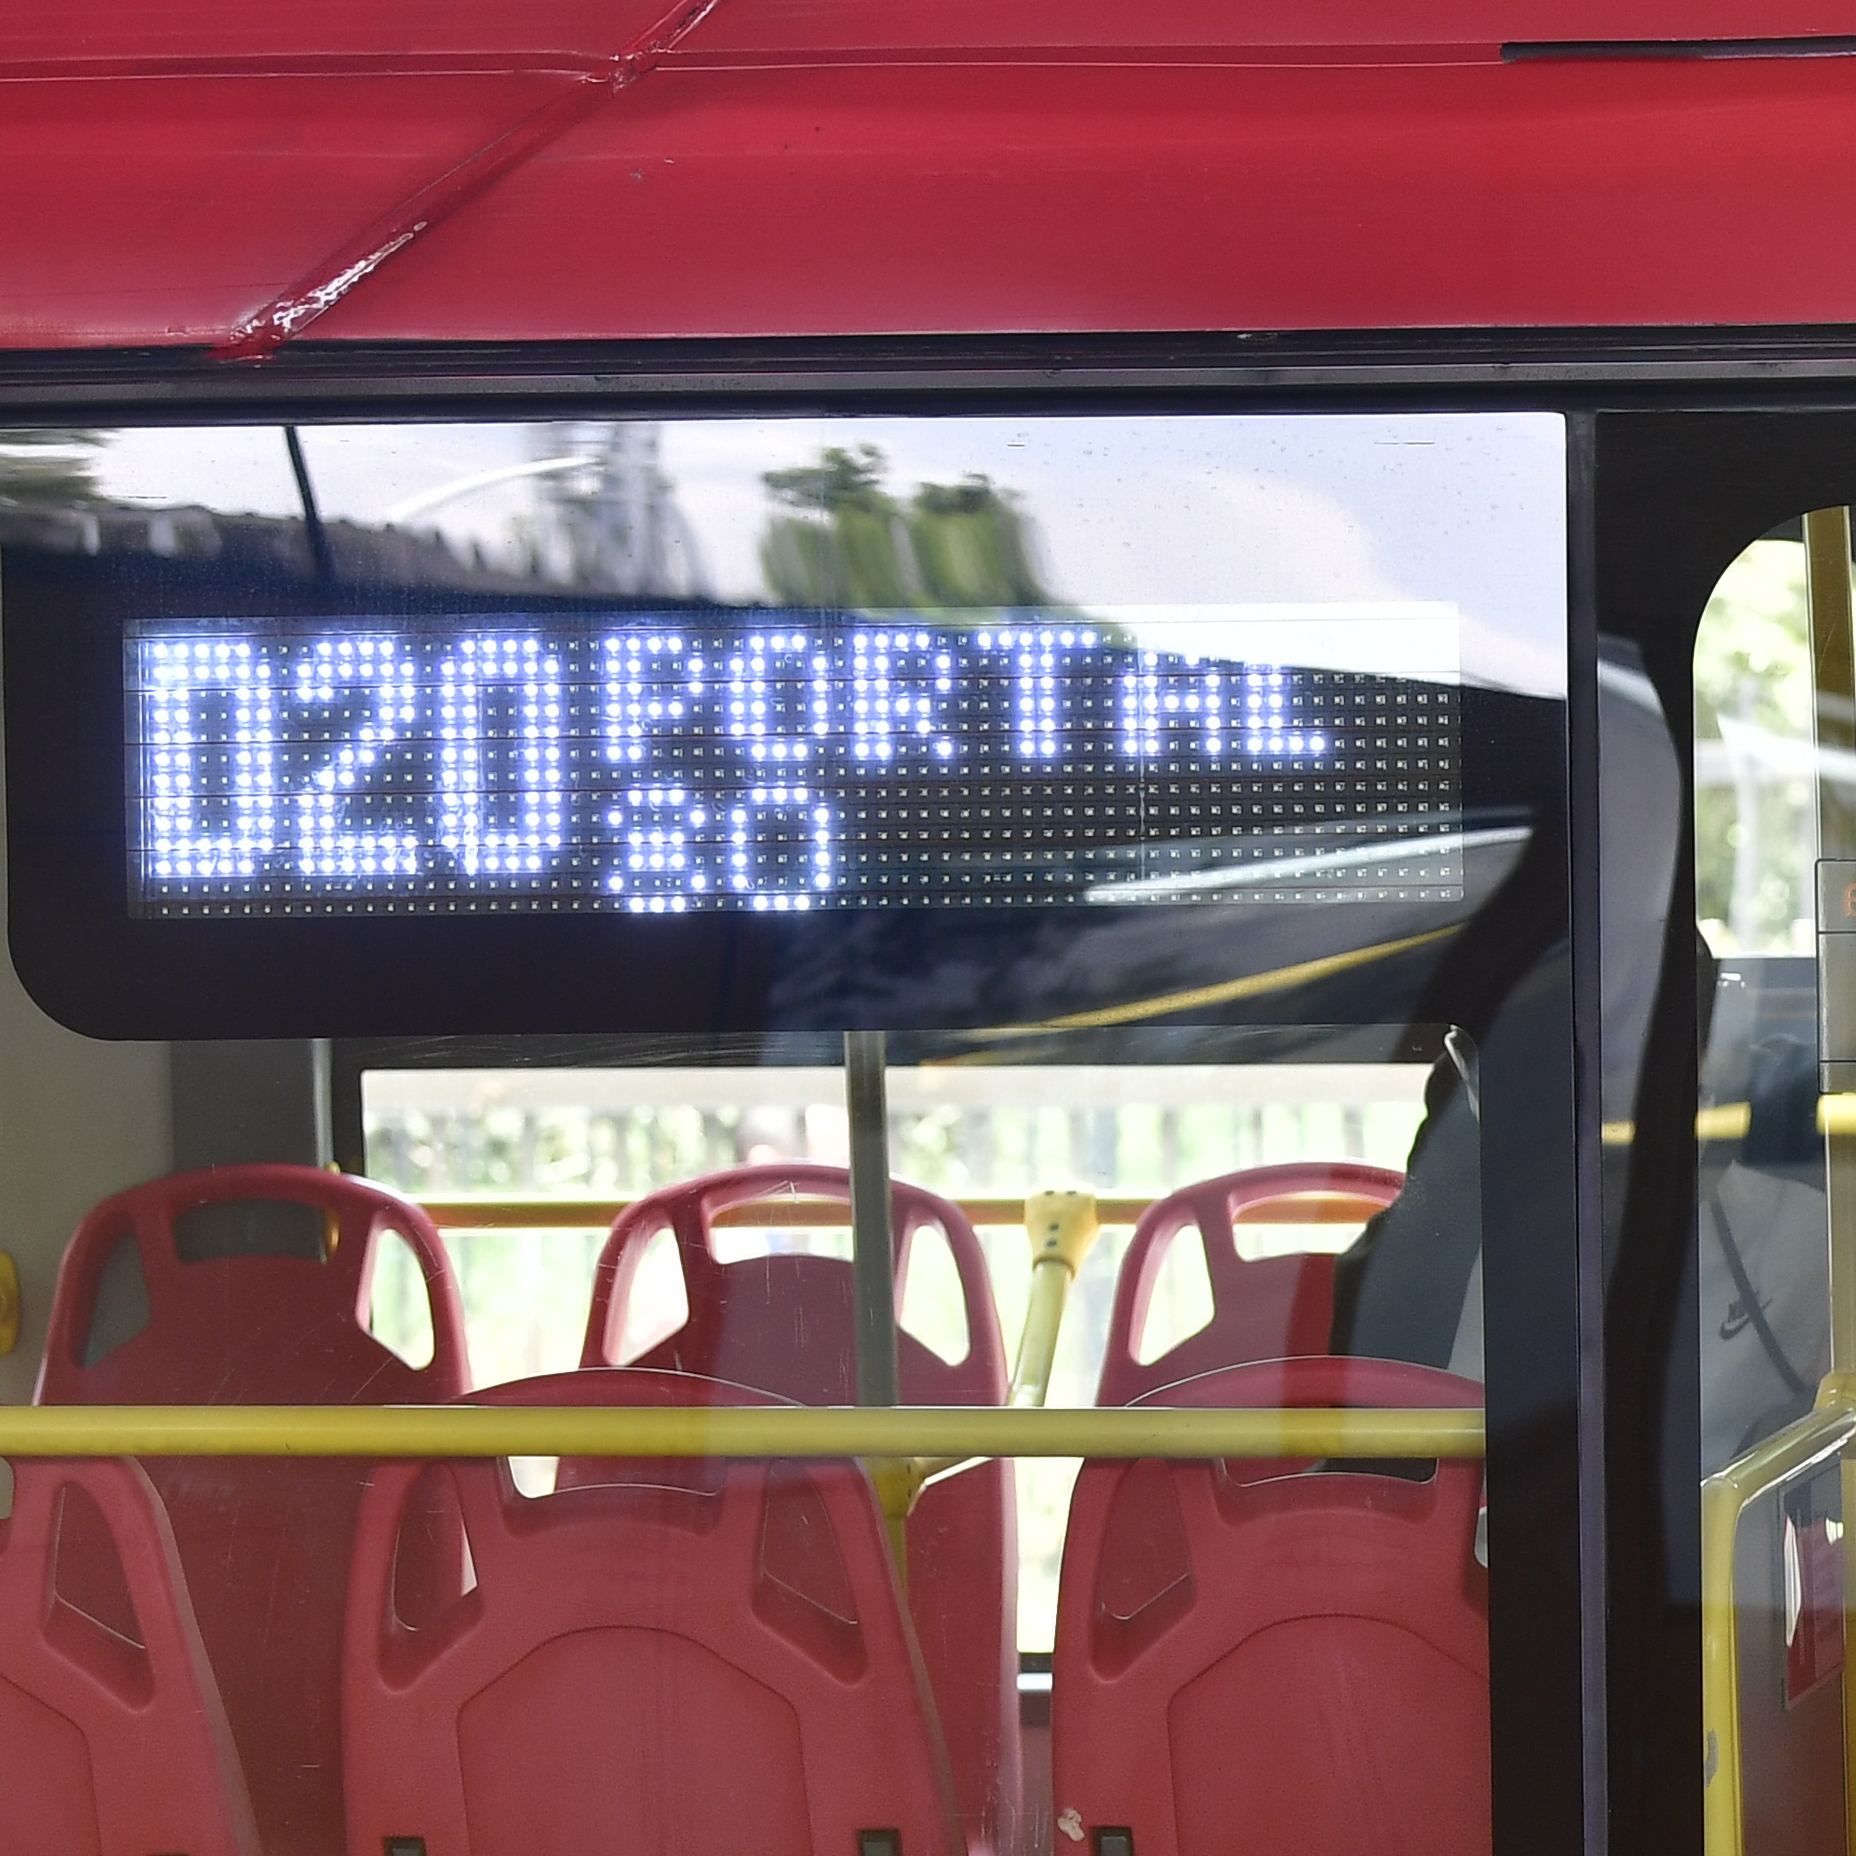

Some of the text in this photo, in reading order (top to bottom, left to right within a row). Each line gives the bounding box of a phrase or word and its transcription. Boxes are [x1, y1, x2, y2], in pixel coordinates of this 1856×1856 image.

[152, 630, 1328, 876] D20 PORTAL
[606, 786, 832, 912] 80
